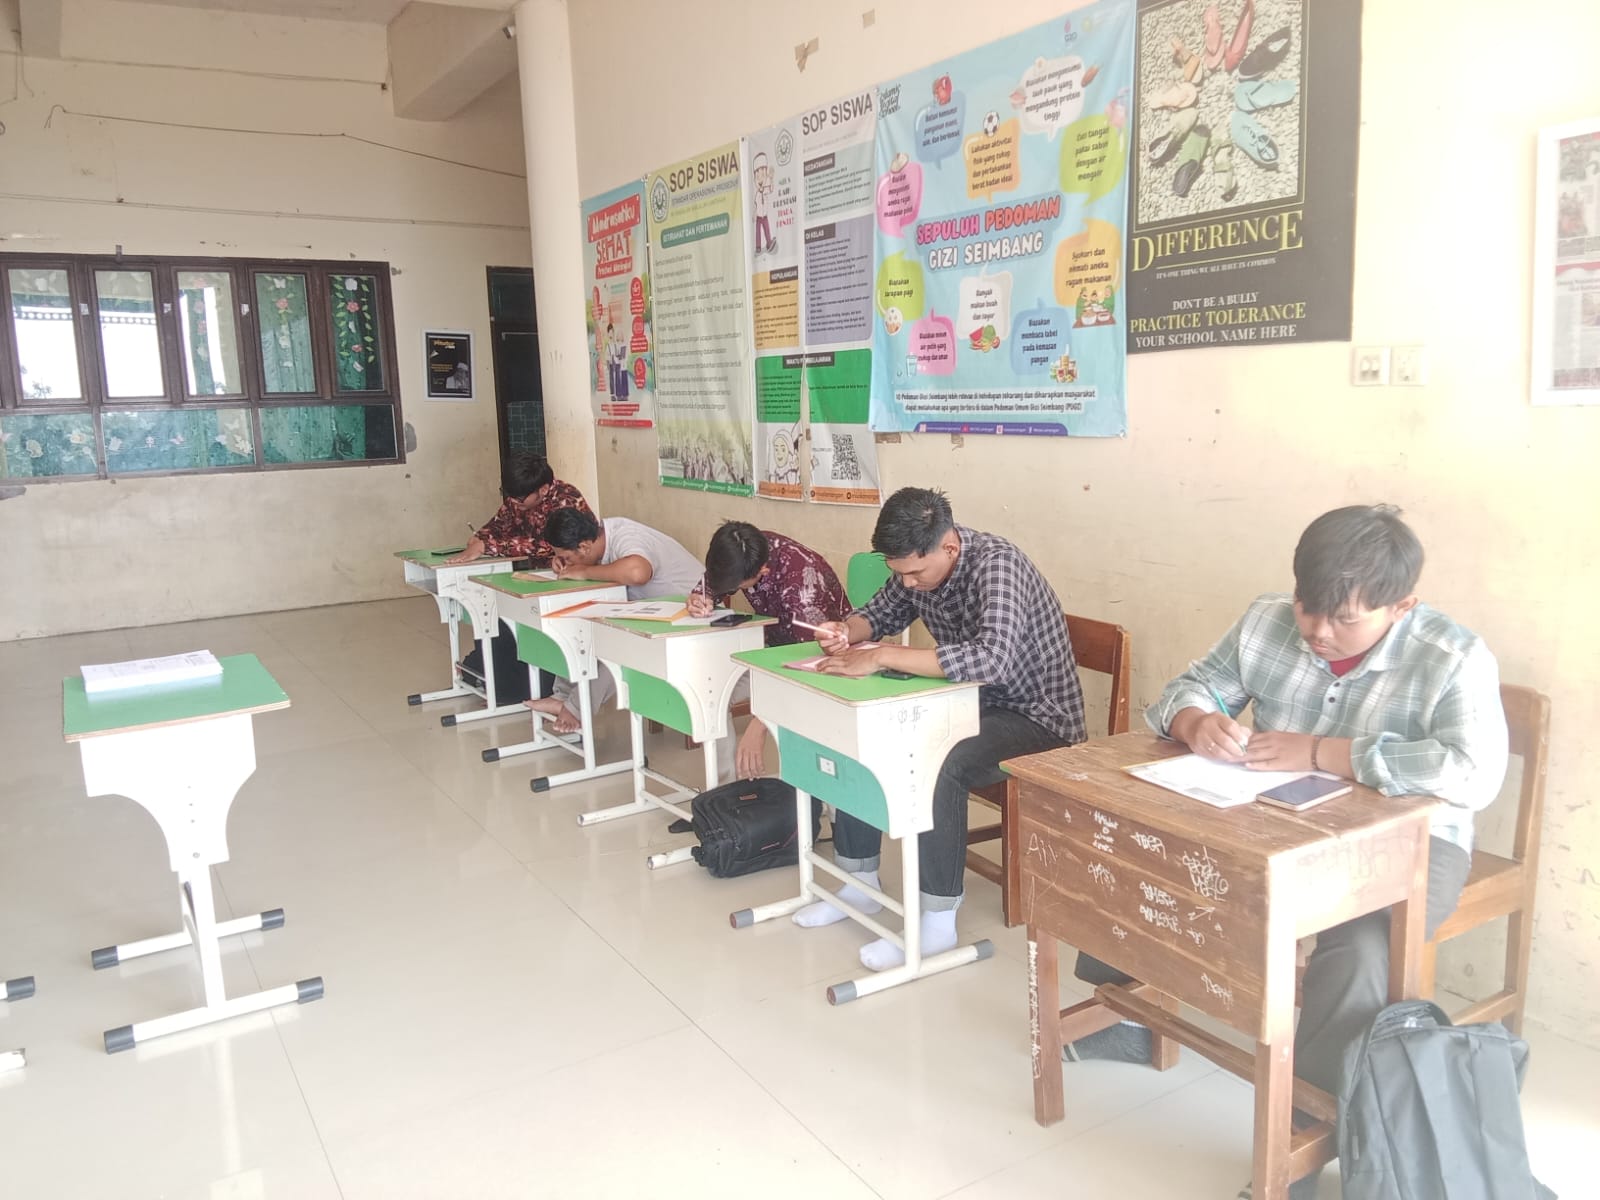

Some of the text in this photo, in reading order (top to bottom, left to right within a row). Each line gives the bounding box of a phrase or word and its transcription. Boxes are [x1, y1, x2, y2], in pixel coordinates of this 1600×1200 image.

[1058, 79, 1073, 92] yang
[1025, 91, 1081, 113] mengandung protein
[801, 109, 828, 137] SOP
[830, 92, 873, 126] SISWA
[1043, 110, 1060, 122] tinggi
[1088, 125, 1110, 139] tangan
[984, 154, 996, 165] yang
[1076, 154, 1107, 169] dengan air
[669, 151, 739, 193] SOP SISWA
[972, 170, 981, 178] dan
[591, 202, 636, 235] Madrasahku
[916, 194, 1061, 247] SEPULUH PEDOMAN
[685, 226, 696, 239] DAN
[696, 219, 729, 235] PERTEMANAN
[595, 228, 633, 265] SEHAT
[1132, 210, 1303, 272] DIFFERENCE
[928, 231, 1044, 272] GIZI SEIMBANG
[1093, 247, 1106, 257] dan
[1089, 260, 1109, 270] aneka
[1064, 274, 1112, 289] ragam makanan
[903, 288, 914, 298] pagi
[1172, 292, 1259, 310] DON'T BE A BULLY
[972, 312, 981, 321] dan
[1130, 302, 1306, 333] PRACTICE TOLERANCE
[1044, 329, 1058, 338] label
[1135, 323, 1298, 349] YOUR SCHOOL NAME HERE
[937, 342, 947, 352] yang
[1022, 343, 1035, 355] pada
[1030, 355, 1049, 368] pangan
[1024, 390, 1033, 399] dan
[1033, 390, 1063, 401] diharapkan
[1064, 388, 1096, 401] masyarakat
[949, 404, 960, 413] yang
[994, 402, 1014, 411] Pedoman
[1040, 402, 1065, 414] Seimbang
